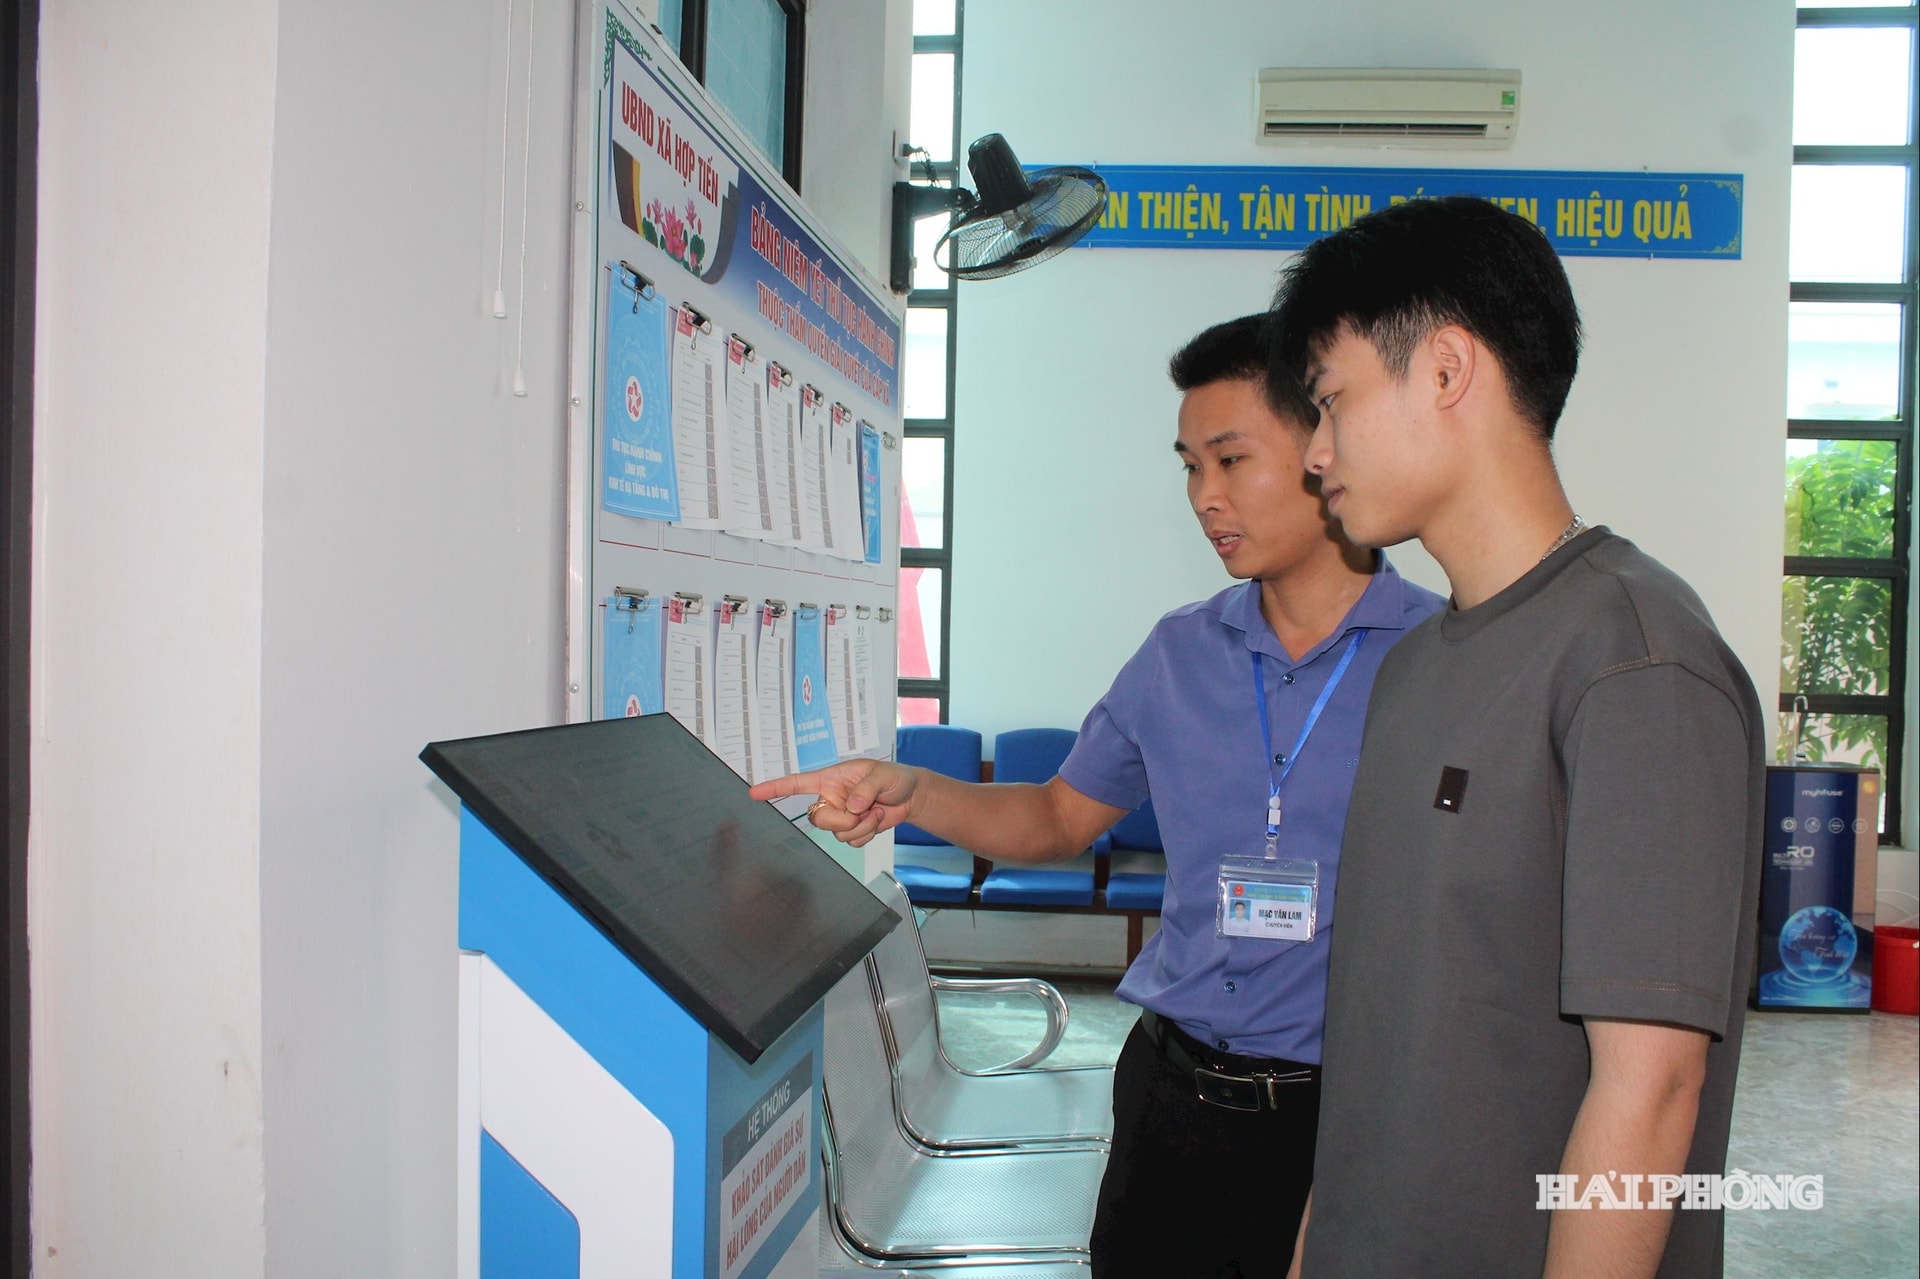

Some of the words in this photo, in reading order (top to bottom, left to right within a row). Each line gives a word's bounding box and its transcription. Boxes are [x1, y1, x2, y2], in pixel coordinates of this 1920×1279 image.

[622, 80, 654, 147] UBND
[657, 116, 672, 165] XÃ
[675, 133, 695, 187] HỢP
[698, 156, 718, 207] TIẾN
[1138, 184, 1229, 239] THIỆN,
[1240, 184, 1296, 239] TẬN
[1556, 190, 1624, 247] HIỆU
[1633, 184, 1693, 244] QUẢ
[751, 201, 781, 272] BẢNG
[783, 236, 808, 295] NIÊM
[810, 258, 826, 309] YẾT
[826, 276, 842, 324] THỦ
[843, 292, 856, 340] TỤC
[857, 305, 875, 354] HÀNH
[757, 280, 784, 332] THUỘC
[785, 301, 807, 346] THẨM
[808, 323, 829, 364] QUYỀN
[1786, 845, 1815, 858] RO
[1259, 909, 1272, 920] MẠC
[748, 1107, 760, 1142] HỆ
[762, 1080, 790, 1126] THỐNG
[732, 1168, 750, 1219] KHẢO
[752, 1157, 764, 1195] SÁT
[765, 1137, 782, 1178] ĐÁNH
[784, 1120, 794, 1156] GIÁ
[796, 1111, 804, 1143] SỰ
[726, 1231, 739, 1271] HÀI
[741, 1208, 758, 1252] LÒNG
[760, 1185, 773, 1227] CỦA
[794, 1150, 806, 1184] DÂN
